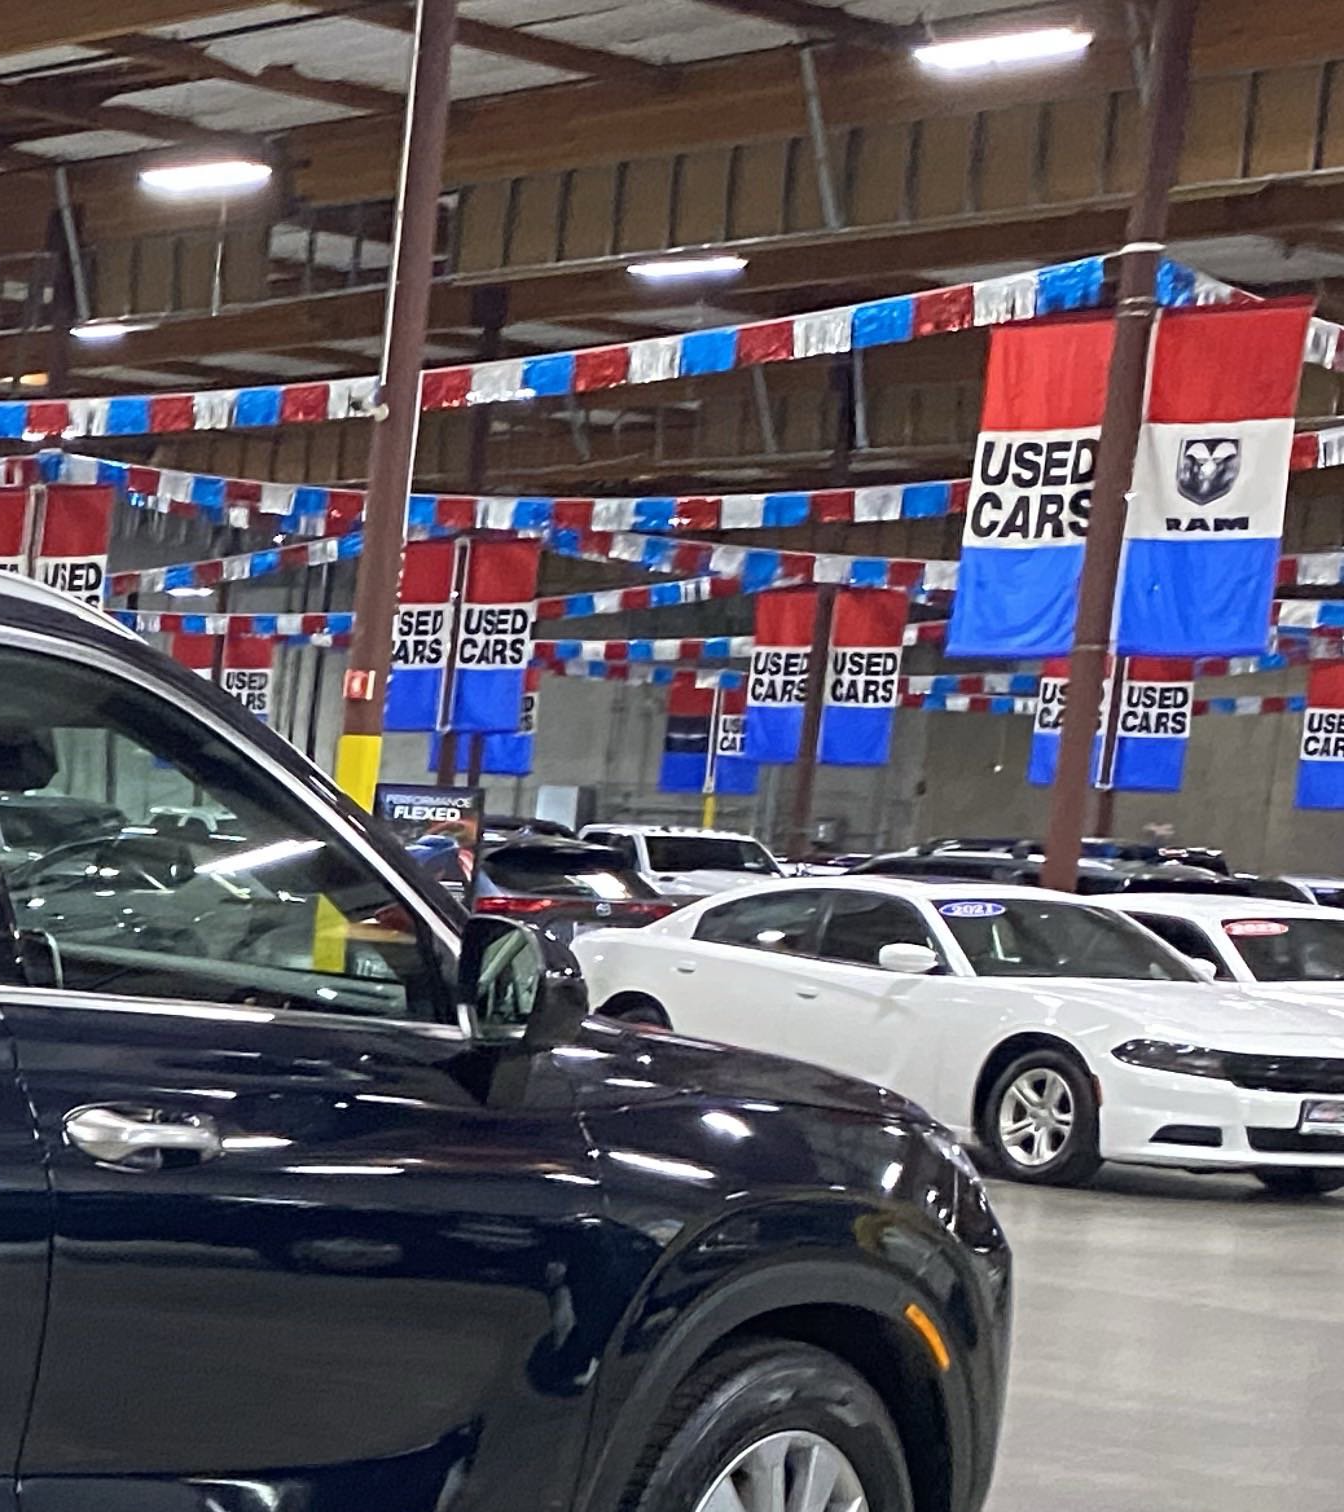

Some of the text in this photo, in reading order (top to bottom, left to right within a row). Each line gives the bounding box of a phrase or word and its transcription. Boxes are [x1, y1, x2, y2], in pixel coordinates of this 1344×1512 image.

[980, 438, 1101, 488] USED
[971, 491, 1091, 538] CARS
[1165, 516, 1249, 531] RAM
[399, 610, 444, 636] SED
[464, 608, 528, 636] USED
[392, 638, 442, 664] ARS
[459, 638, 525, 664] CARS
[832, 652, 898, 676] USED
[226, 672, 268, 690] USED
[751, 678, 808, 702] CARS
[831, 678, 895, 703] CARS
[1127, 686, 1189, 709] USED
[1120, 711, 1187, 734] CARS
[1308, 713, 1344, 733] USE
[1304, 736, 1344, 757] CAR
[393, 805, 461, 821] FLEXED
